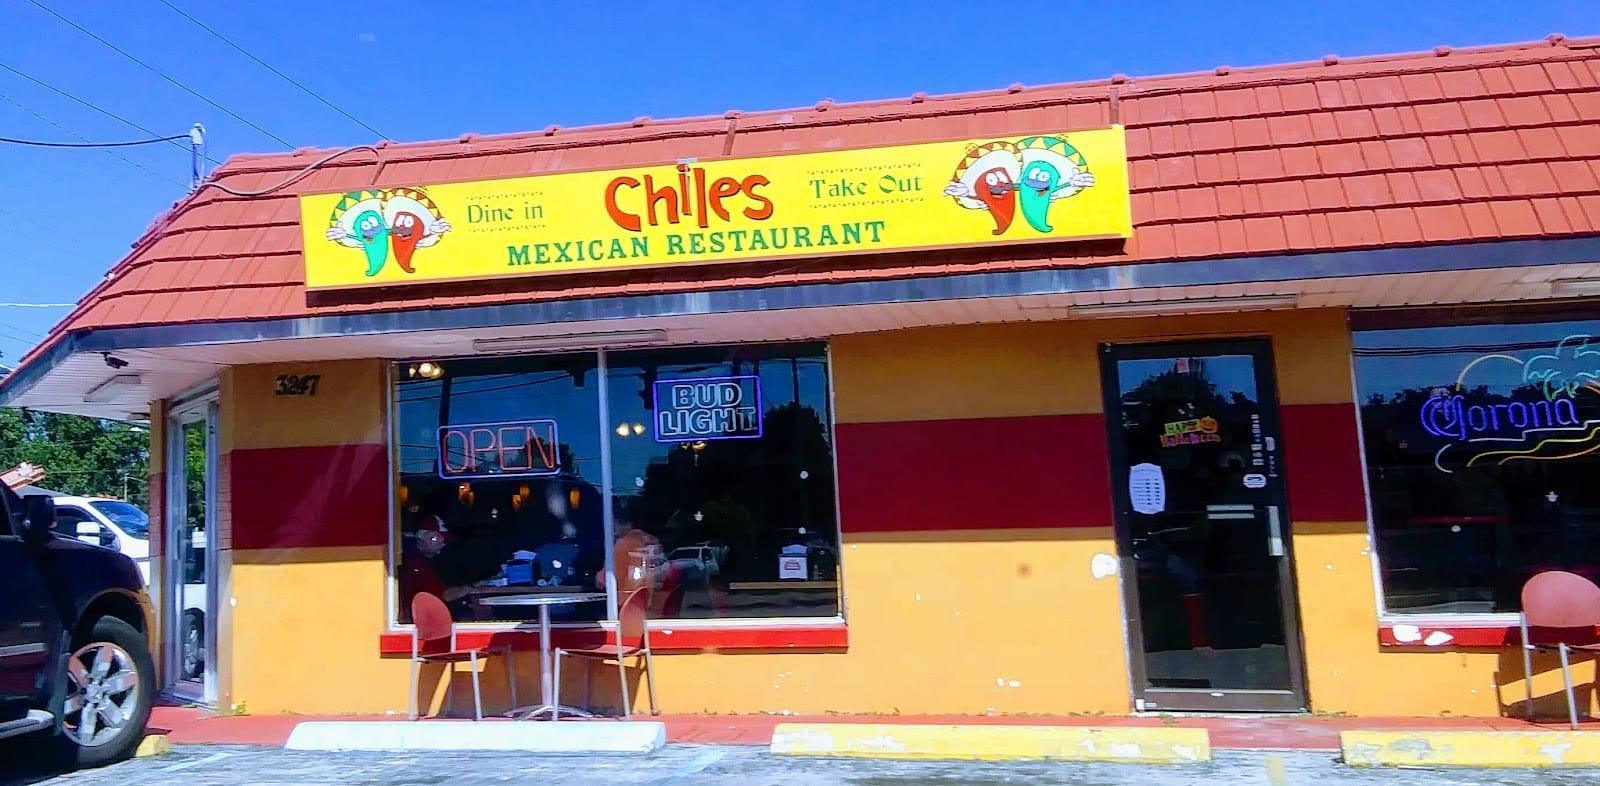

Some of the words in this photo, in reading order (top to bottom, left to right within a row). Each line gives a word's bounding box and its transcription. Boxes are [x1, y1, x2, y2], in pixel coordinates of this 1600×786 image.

[604, 163, 773, 232] Chiles
[808, 178, 868, 198] Take
[878, 174, 923, 194] Out
[467, 204, 514, 223] Dine
[524, 201, 543, 219] in
[507, 236, 649, 266] MEXICAN
[666, 220, 885, 255] RESTAURANT
[672, 382, 742, 409] BUD
[660, 407, 757, 435] LIGHT
[1420, 394, 1580, 440] Corona
[442, 424, 555, 473] OPEN
